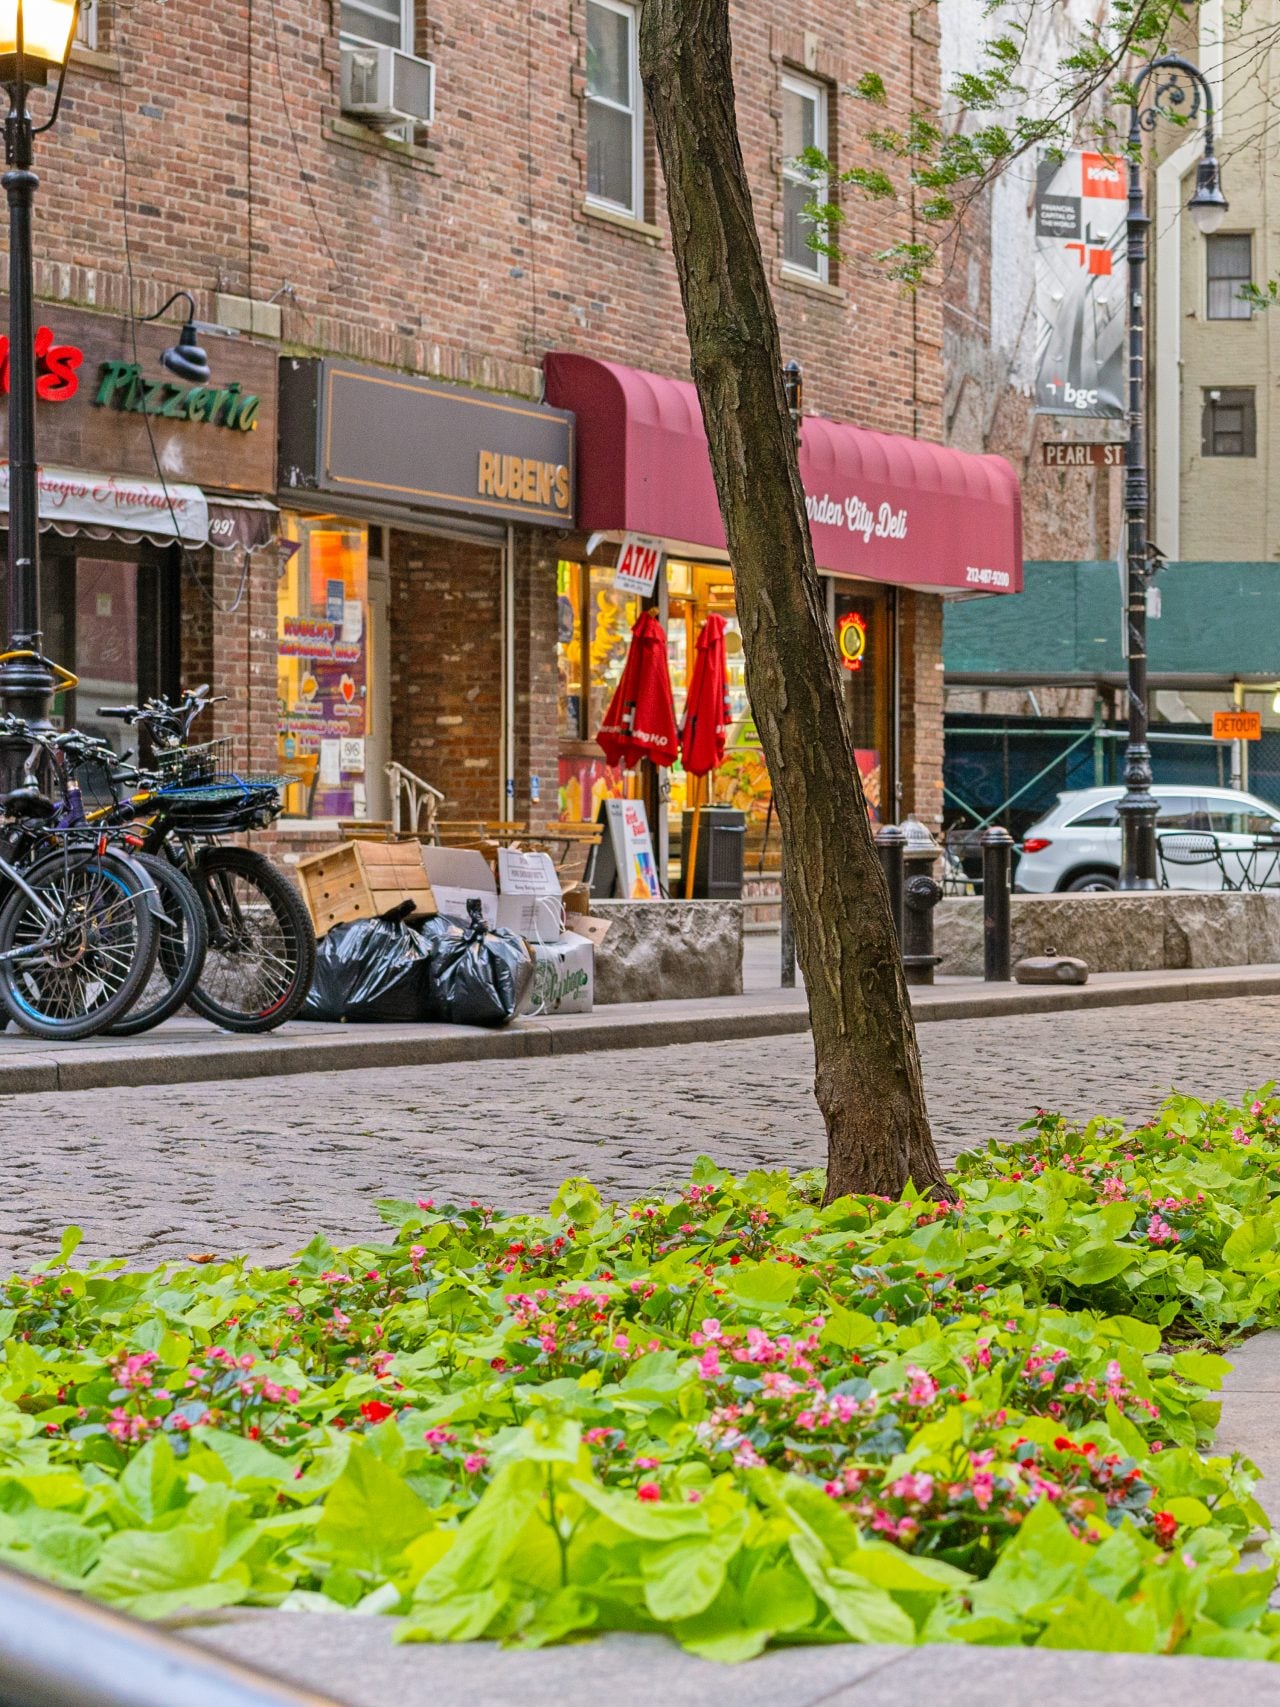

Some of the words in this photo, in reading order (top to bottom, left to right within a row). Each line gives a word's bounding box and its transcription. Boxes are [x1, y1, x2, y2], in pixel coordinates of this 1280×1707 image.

[1041, 203, 1075, 214] FINANCIAL
[1041, 211, 1066, 220] CAPITAL
[1066, 213, 1076, 221] OF
[1041, 219, 1053, 227] THE
[1053, 220, 1077, 229] WORLD
[97, 359, 260, 432] Pizzeria
[1063, 382, 1098, 409] bgc
[1046, 445, 1095, 465] PEARL
[1104, 445, 1123, 465] ST
[478, 449, 570, 509] RUBEN'S
[803, 485, 844, 527] arden
[845, 495, 874, 543] City
[875, 502, 908, 539] Deli
[619, 543, 657, 581] ATM
[1216, 718, 1257, 732] DETOUR
